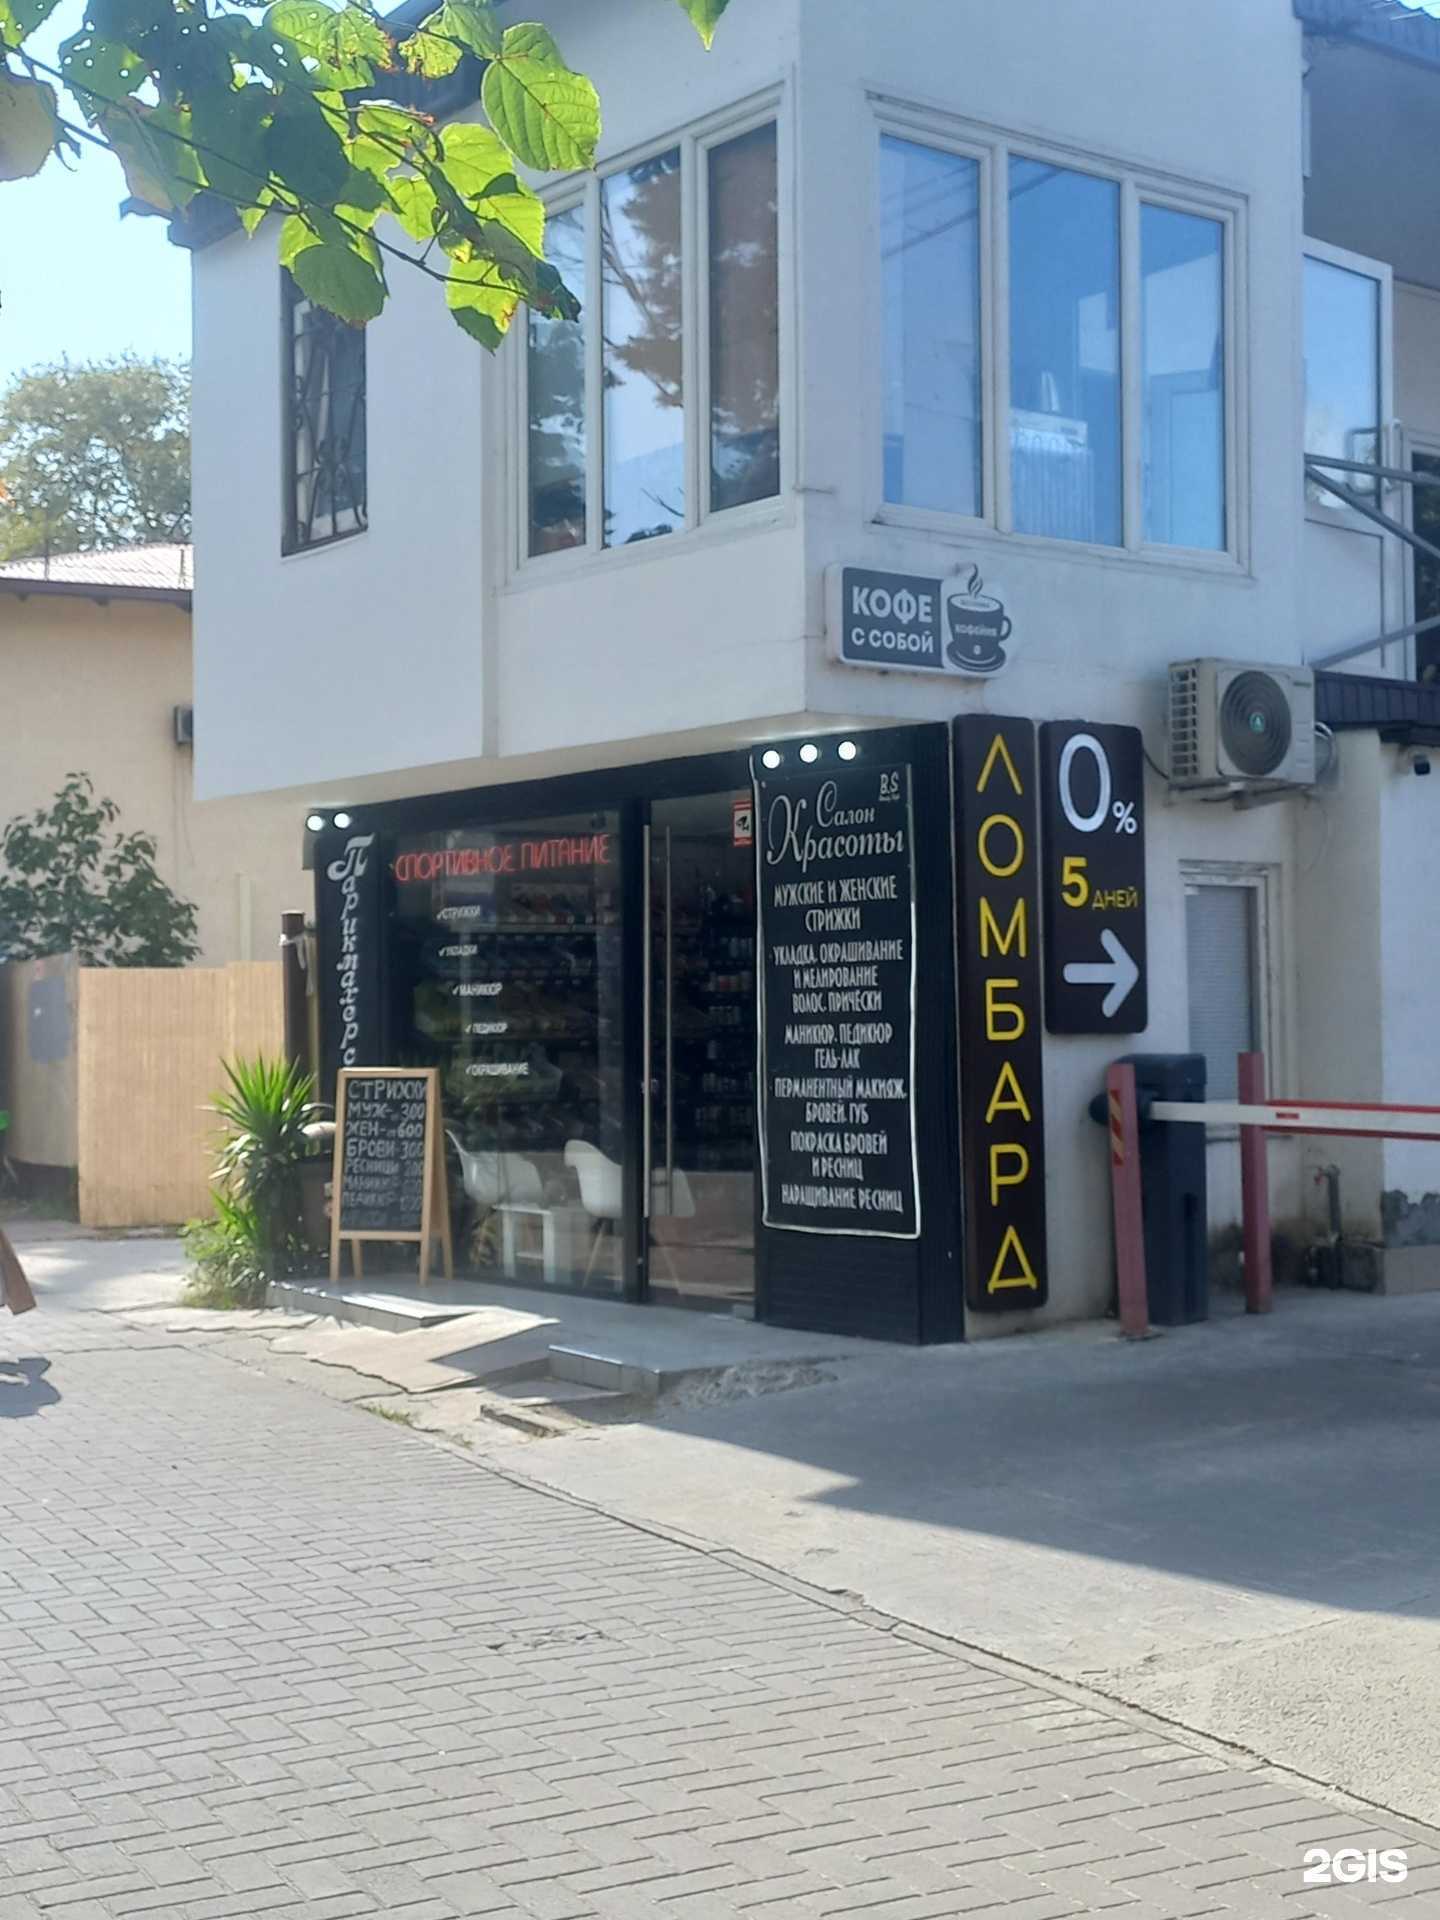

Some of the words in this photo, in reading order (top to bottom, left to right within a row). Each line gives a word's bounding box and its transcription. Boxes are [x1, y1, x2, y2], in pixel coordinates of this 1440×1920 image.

[852, 586, 933, 624] КОФЕ
[851, 627, 865, 646] С
[869, 630, 934, 653] СОБОЙ
[816, 780, 875, 827] Салон
[766, 794, 904, 873] Красоты
[395, 845, 516, 883] СПОРТИВНОЕ
[521, 833, 612, 868] ПИТАНИЕ
[773, 881, 825, 907] МУЖСКИЕ
[828, 881, 838, 903] И
[840, 875, 898, 900] ЖЕНСКИЕ
[1061, 856, 1089, 908] 5
[1092, 885, 1138, 909] ДНЕЙ
[805, 907, 861, 932] СТРИЖКИ
[327, 833, 375, 1065] Парикмахерс
[820, 938, 904, 963] ОКРАШИВАНИЕ
[793, 968, 801, 989] И
[802, 965, 878, 989] МЕЛИРОВАНИЕ
[976, 734, 1037, 1294] ЛОМБАРД
[839, 1023, 892, 1044] ПЕДИКЮР
[815, 1048, 860, 1069] ГЕЛЬ-ЛАК
[774, 1075, 853, 1098] ПЕРМАНЕНТНЫЙ
[849, 1103, 869, 1124] ГУБ
[790, 1131, 841, 1152] ПОКРАСКА
[843, 1130, 887, 1154] БРОВЕЙ
[812, 1157, 821, 1177] И
[822, 1158, 863, 1180] РЕСНИЦ
[781, 1184, 856, 1209] НАРАЩИВАНИЕ
[857, 1188, 903, 1212] РЕСНИЦ
